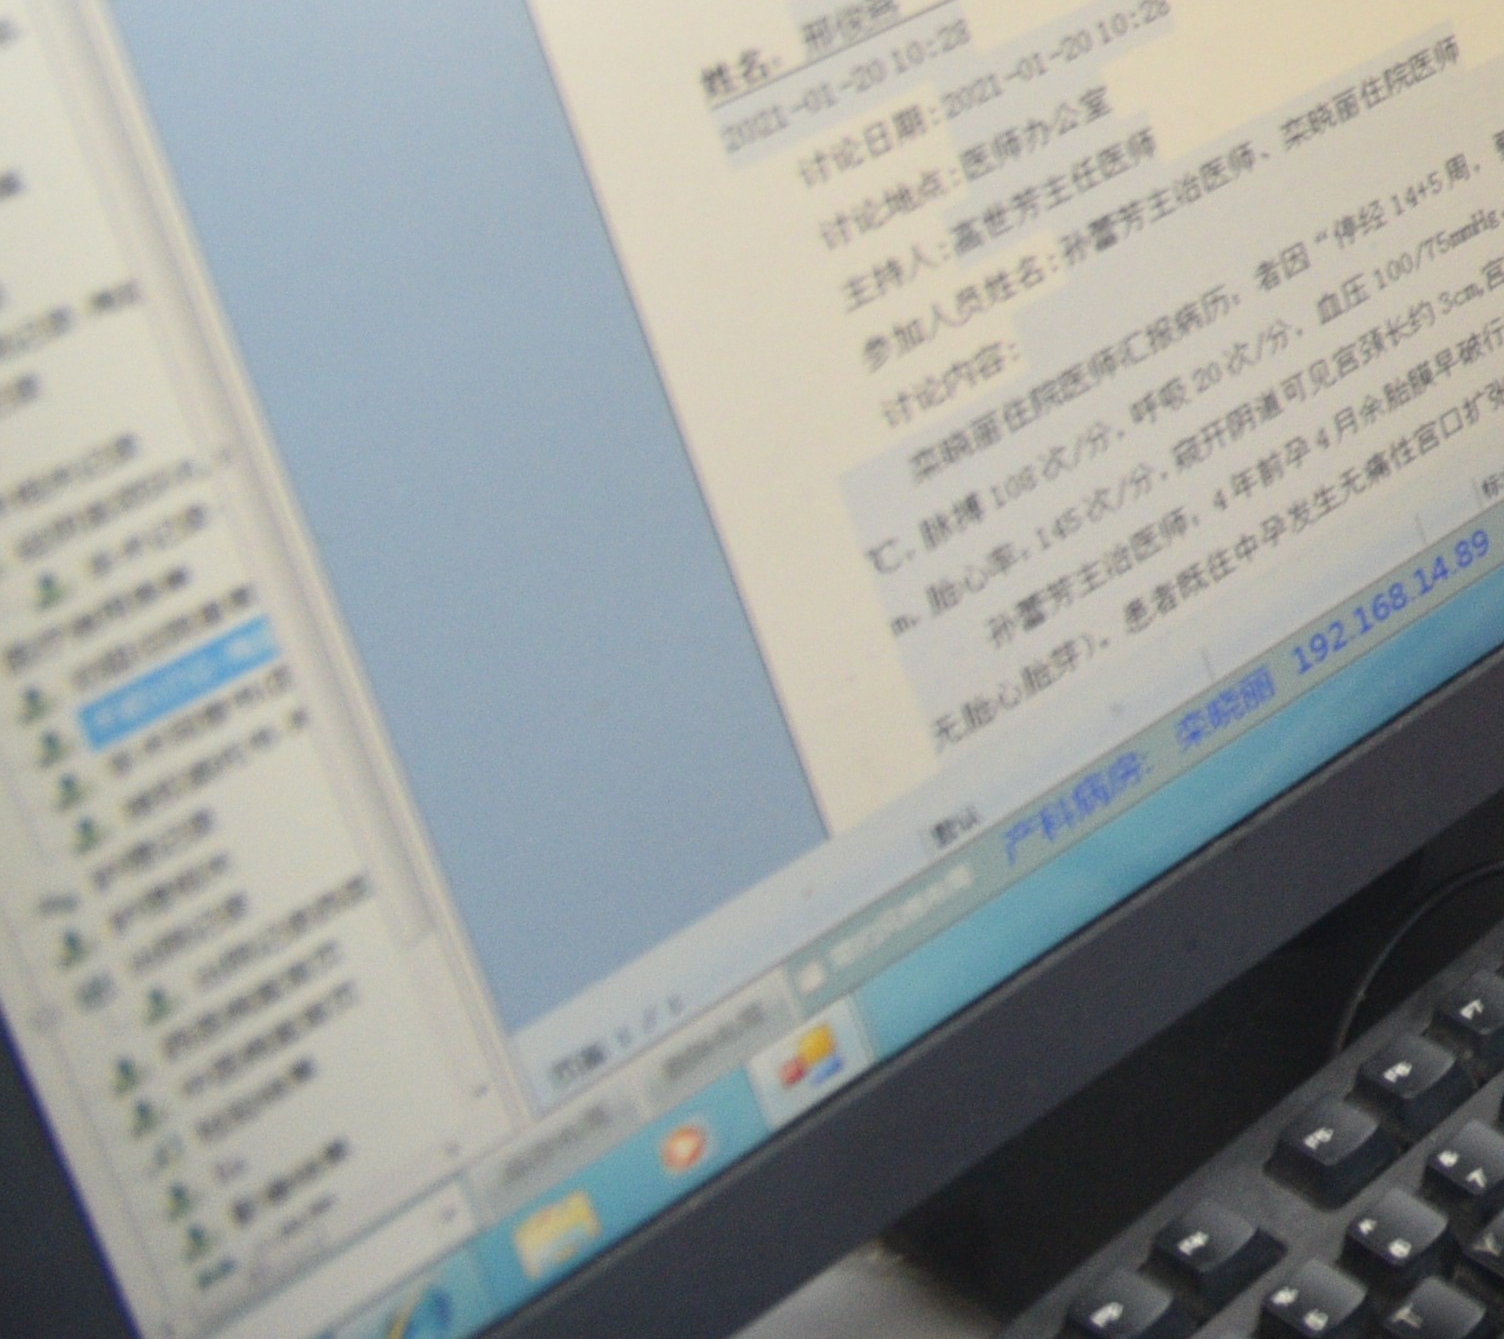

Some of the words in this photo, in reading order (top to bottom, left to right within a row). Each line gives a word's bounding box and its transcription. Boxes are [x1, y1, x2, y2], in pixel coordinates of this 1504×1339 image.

[720, 54, 887, 156] 2021-01-20
[891, 15, 972, 76] 10:28
[817, 81, 1113, 255] 讨论地点:医师办公室
[1292, 528, 1491, 676] 192.168.14.89
[1474, 1231, 1500, 1256] Y
